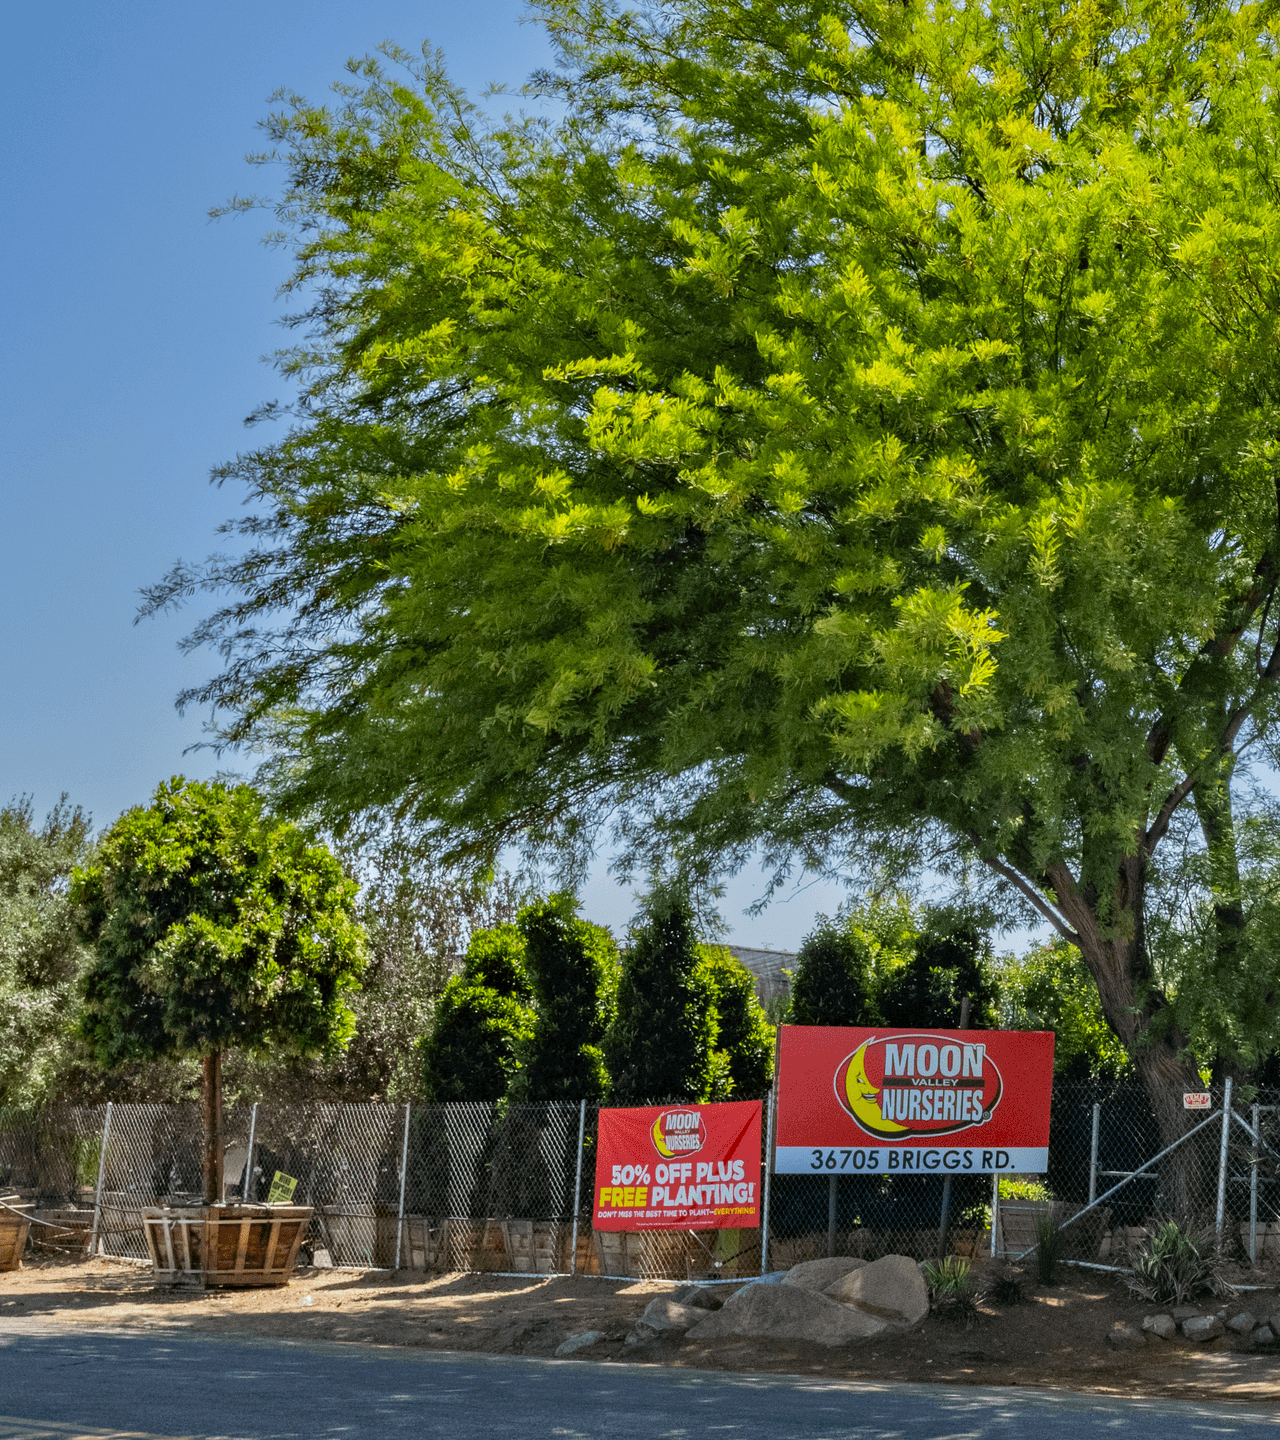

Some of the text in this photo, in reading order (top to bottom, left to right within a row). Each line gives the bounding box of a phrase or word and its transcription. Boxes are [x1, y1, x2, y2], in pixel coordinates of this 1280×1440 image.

[884, 1043, 984, 1077] MOON
[911, 1078, 959, 1087] VALLEY
[881, 1088, 984, 1122] NURSERIES
[665, 1111, 701, 1130] MOON
[665, 1133, 701, 1151] NURSERIES
[810, 1149, 1015, 1170] 36705 BRIGGS RD.
[611, 1159, 745, 1186] 50% OFF PLUS
[599, 1182, 755, 1207] FREE PLANTING!
[618, 1210, 633, 1218] MISS
[678, 1209, 688, 1217] TO
